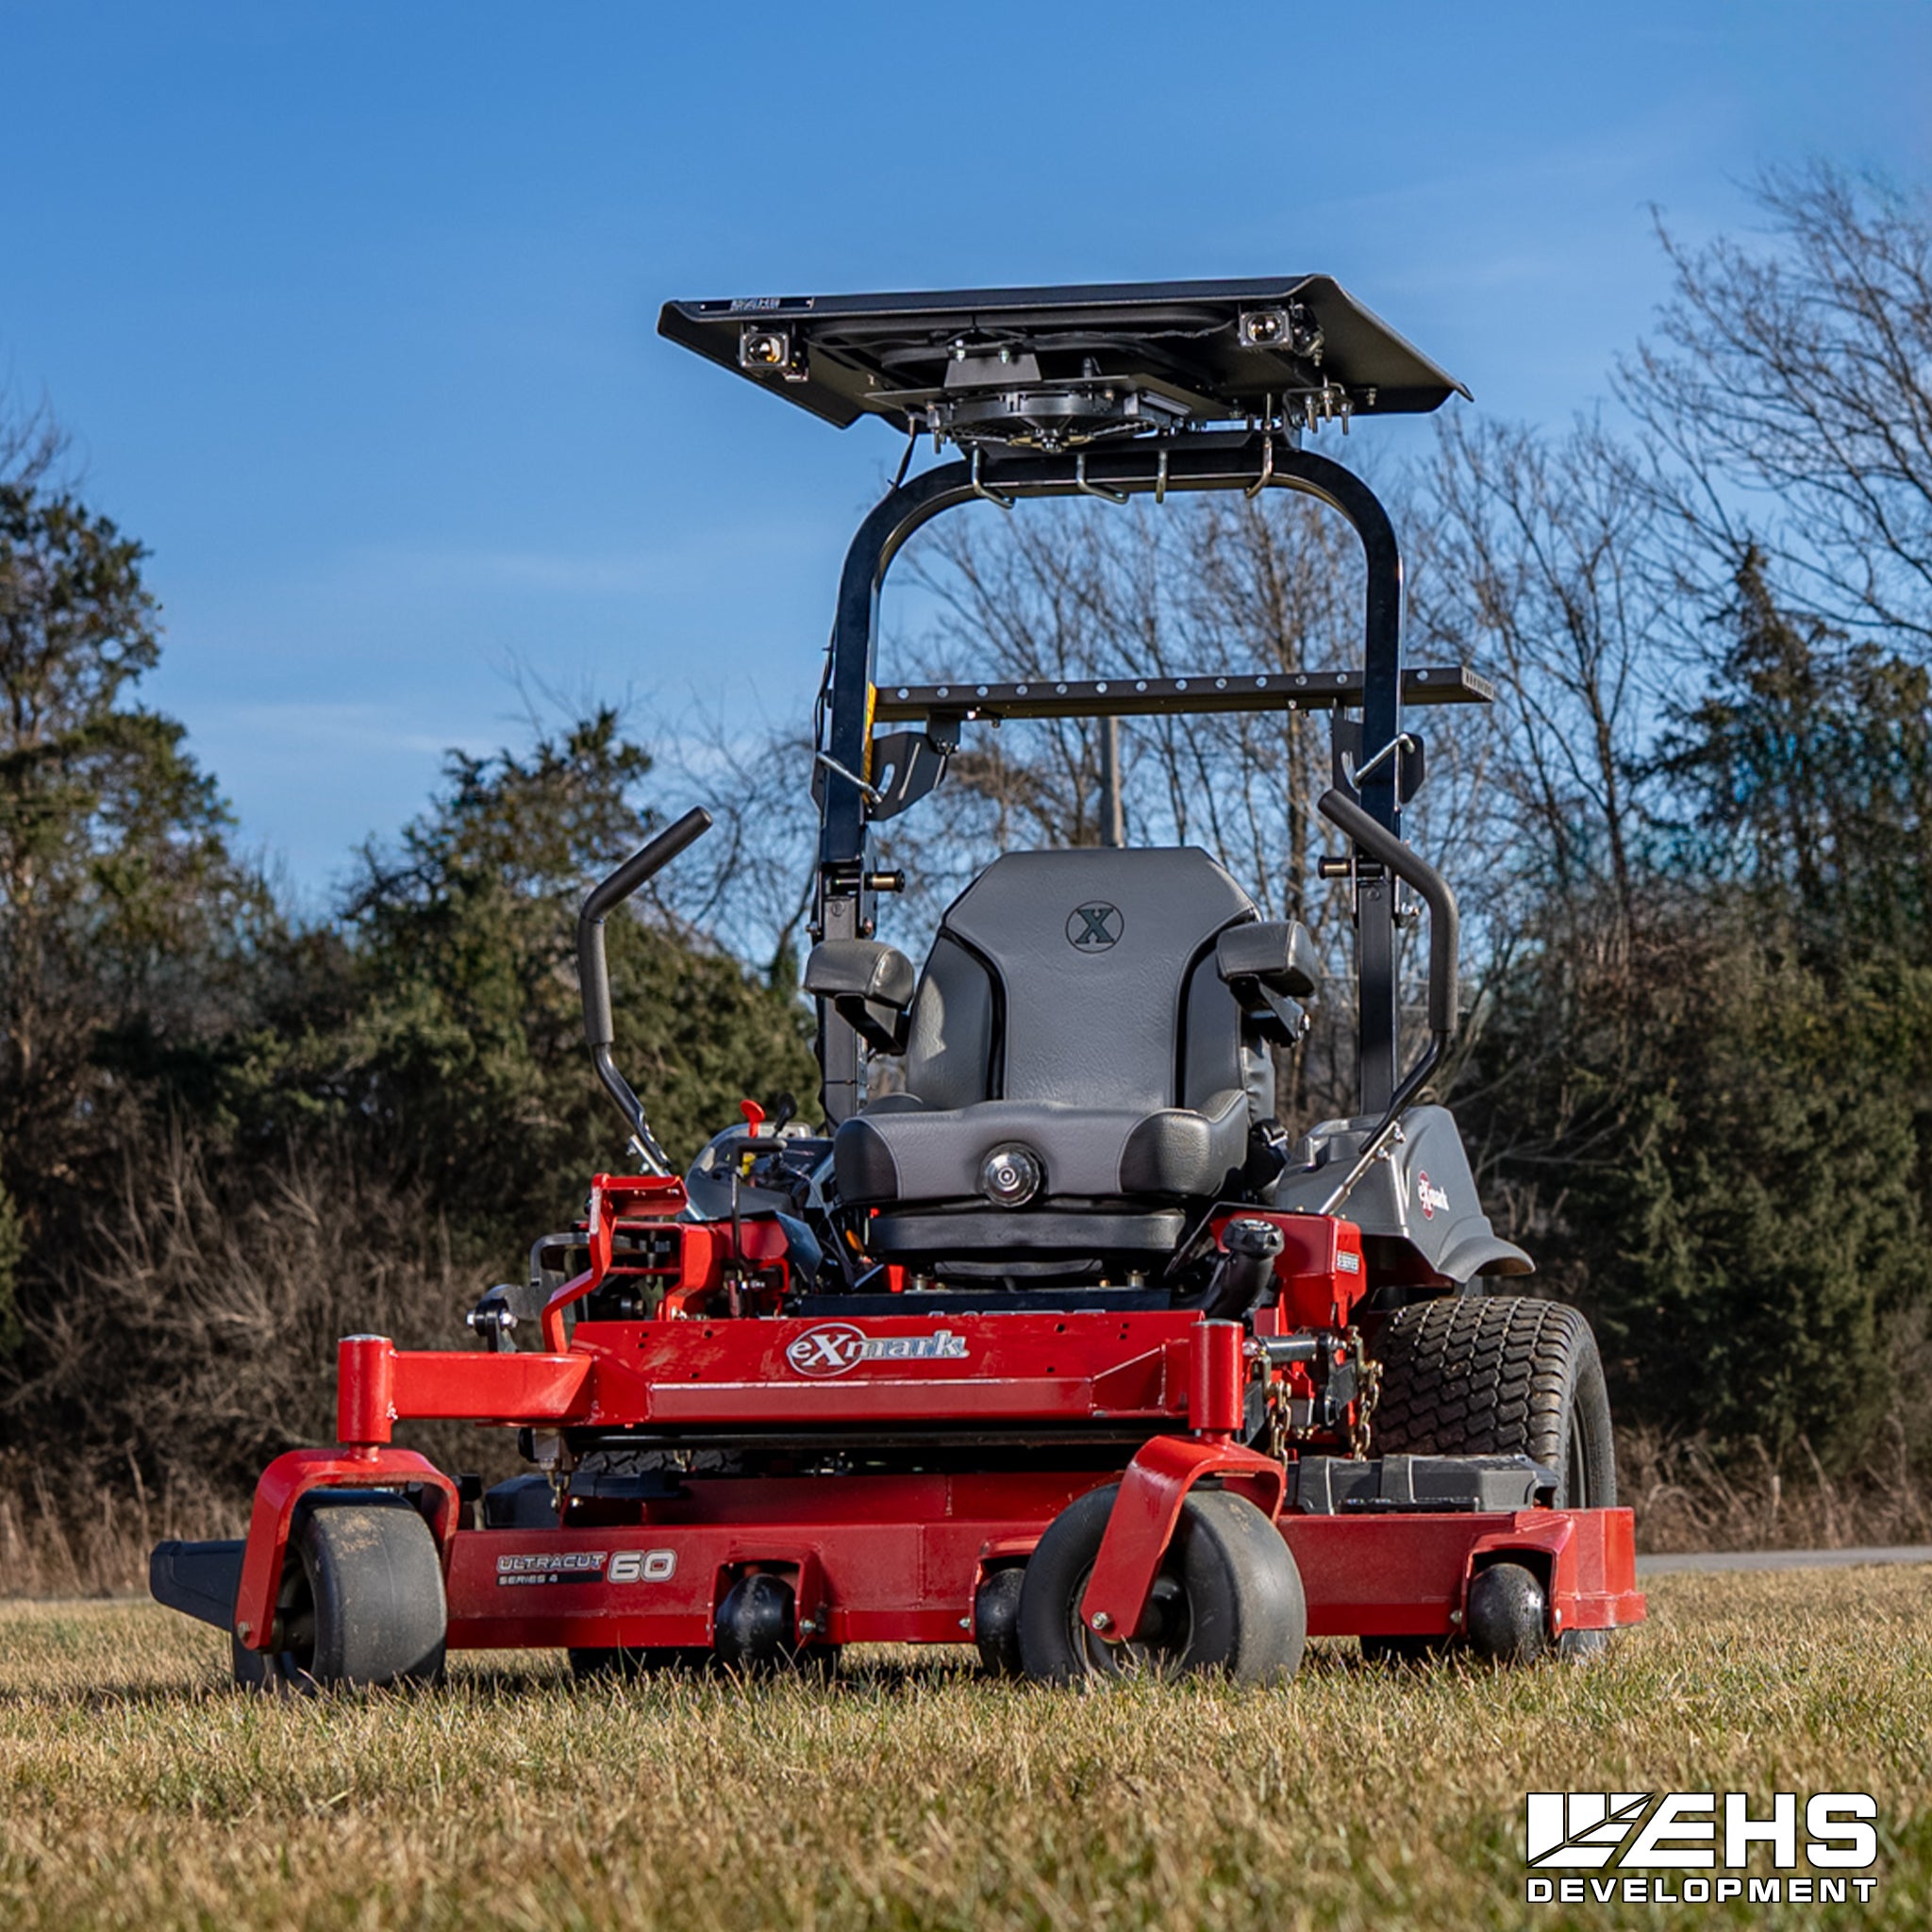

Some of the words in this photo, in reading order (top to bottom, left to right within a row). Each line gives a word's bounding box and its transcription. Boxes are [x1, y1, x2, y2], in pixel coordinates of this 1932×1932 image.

[1074, 908, 1115, 944] X
[497, 1552, 607, 1573] ULTRACUT
[608, 1550, 677, 1582] 60
[499, 1574, 546, 1585] SERIES
